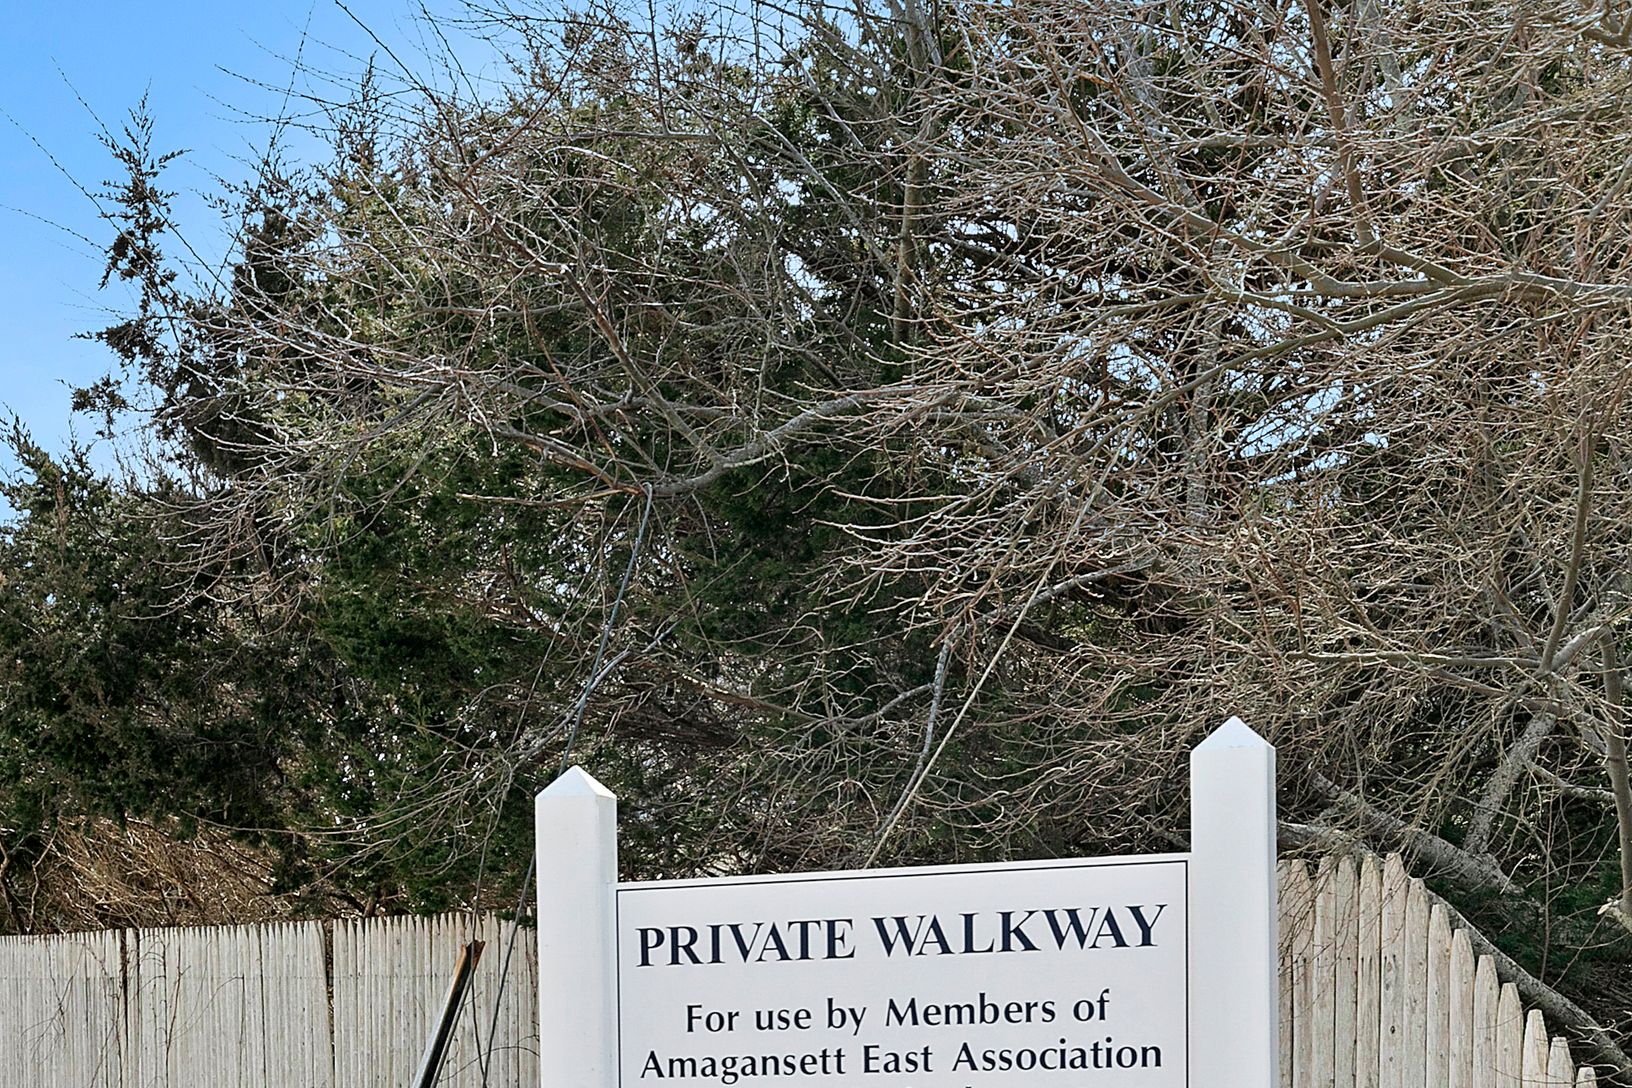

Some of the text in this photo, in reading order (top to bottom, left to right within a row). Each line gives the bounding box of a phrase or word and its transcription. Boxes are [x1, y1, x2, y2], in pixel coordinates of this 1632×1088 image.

[634, 903, 1168, 968] PRIVATE WALKWAY
[686, 988, 1110, 1037] For use by Members of
[639, 1036, 1162, 1086] Amagansett East Association
